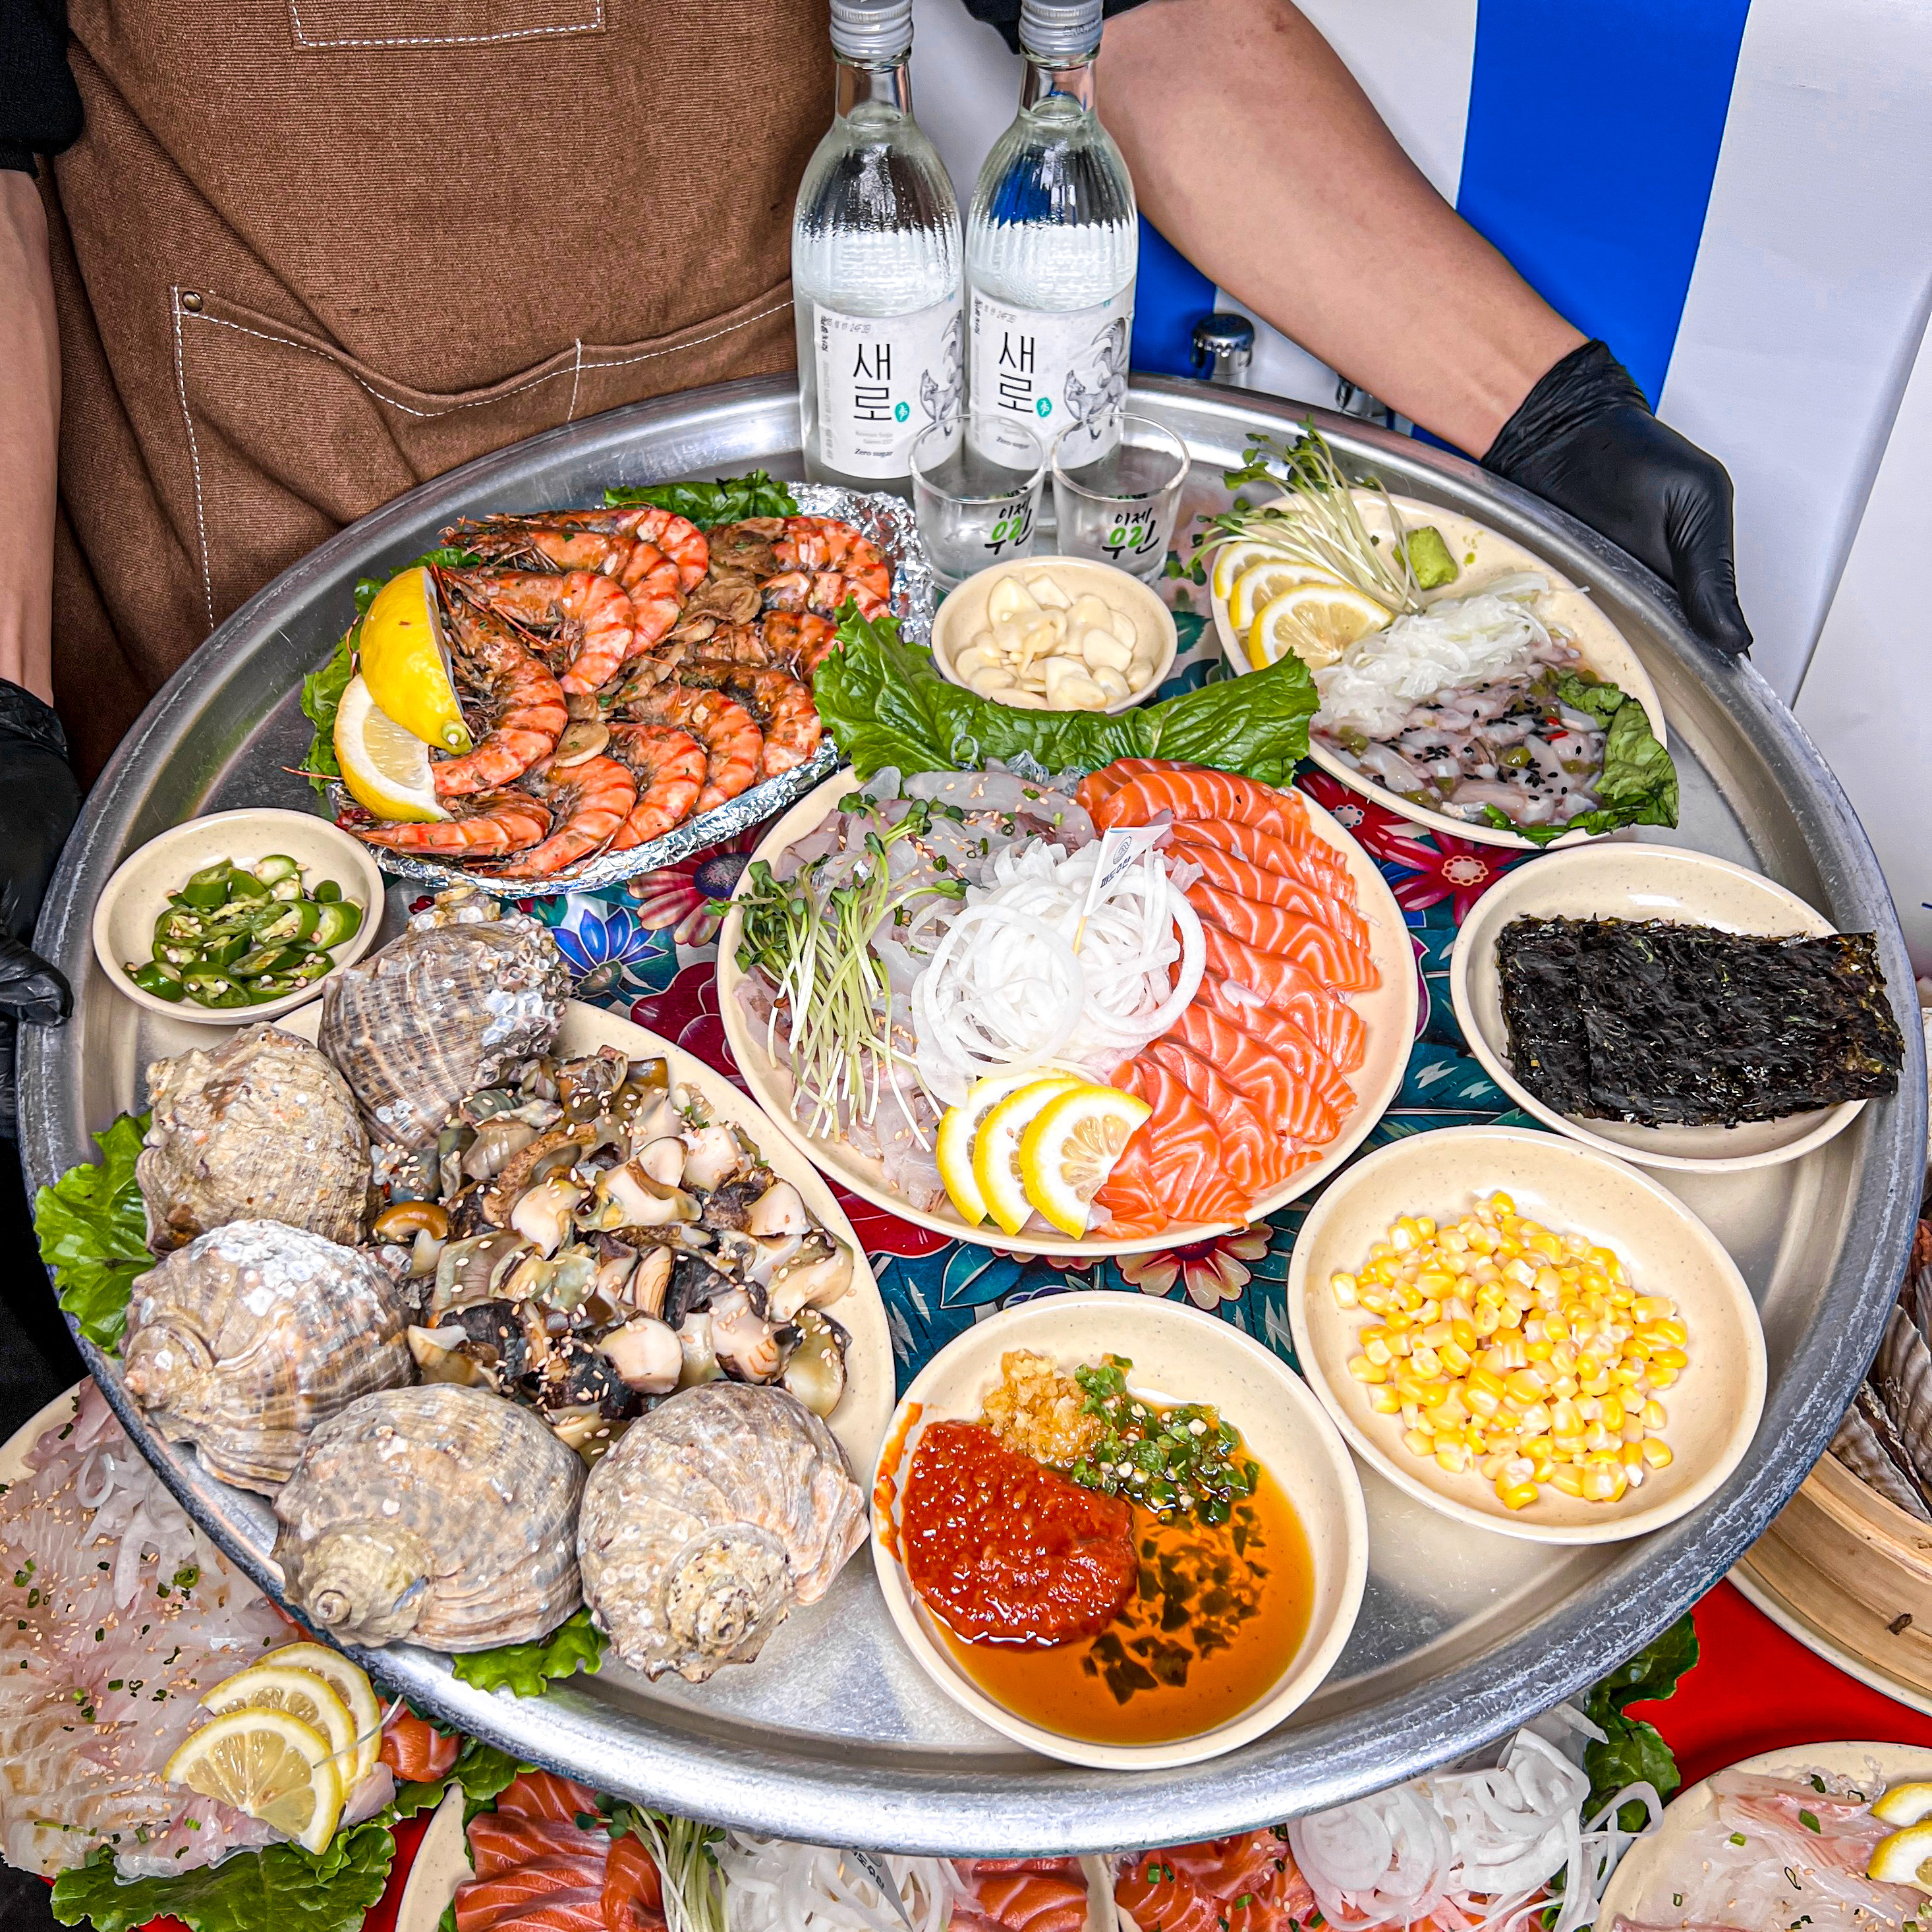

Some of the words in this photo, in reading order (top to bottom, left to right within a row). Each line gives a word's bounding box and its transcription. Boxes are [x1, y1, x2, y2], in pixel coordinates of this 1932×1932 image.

[853, 343, 892, 421] 새로
[998, 331, 1035, 413] 새로
[999, 496, 1031, 519] 이제
[1115, 507, 1153, 526] 이제
[984, 508, 1033, 555] 우린
[1102, 520, 1160, 560] 우린
[851, 1850, 884, 1890] 도수산
